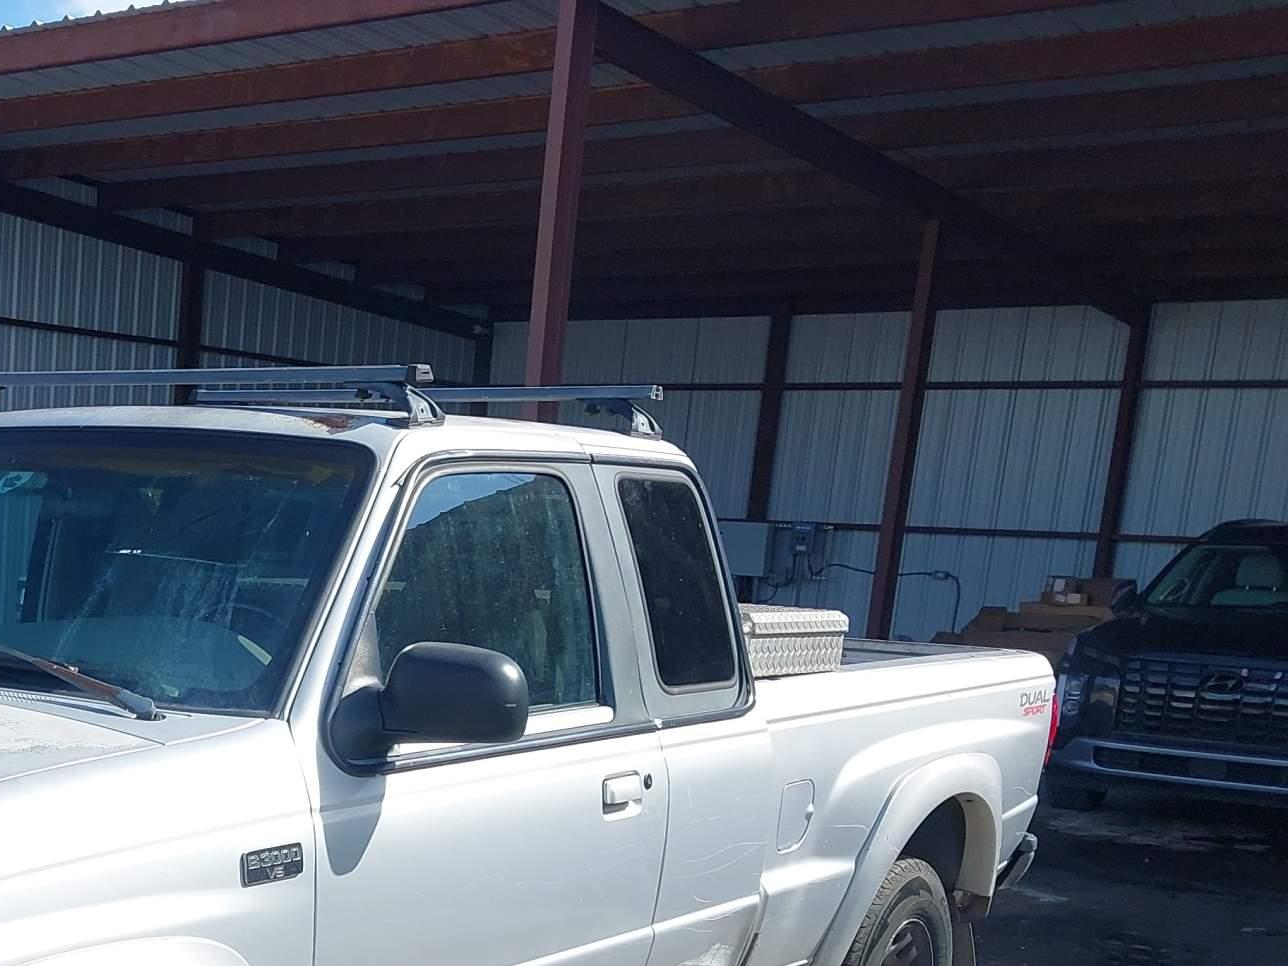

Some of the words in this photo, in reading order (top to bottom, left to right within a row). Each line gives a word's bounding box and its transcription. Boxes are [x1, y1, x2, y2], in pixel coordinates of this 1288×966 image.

[1019, 689, 1050, 707] DUAL
[1022, 703, 1048, 717] SPORT
[247, 847, 301, 870] B3000
